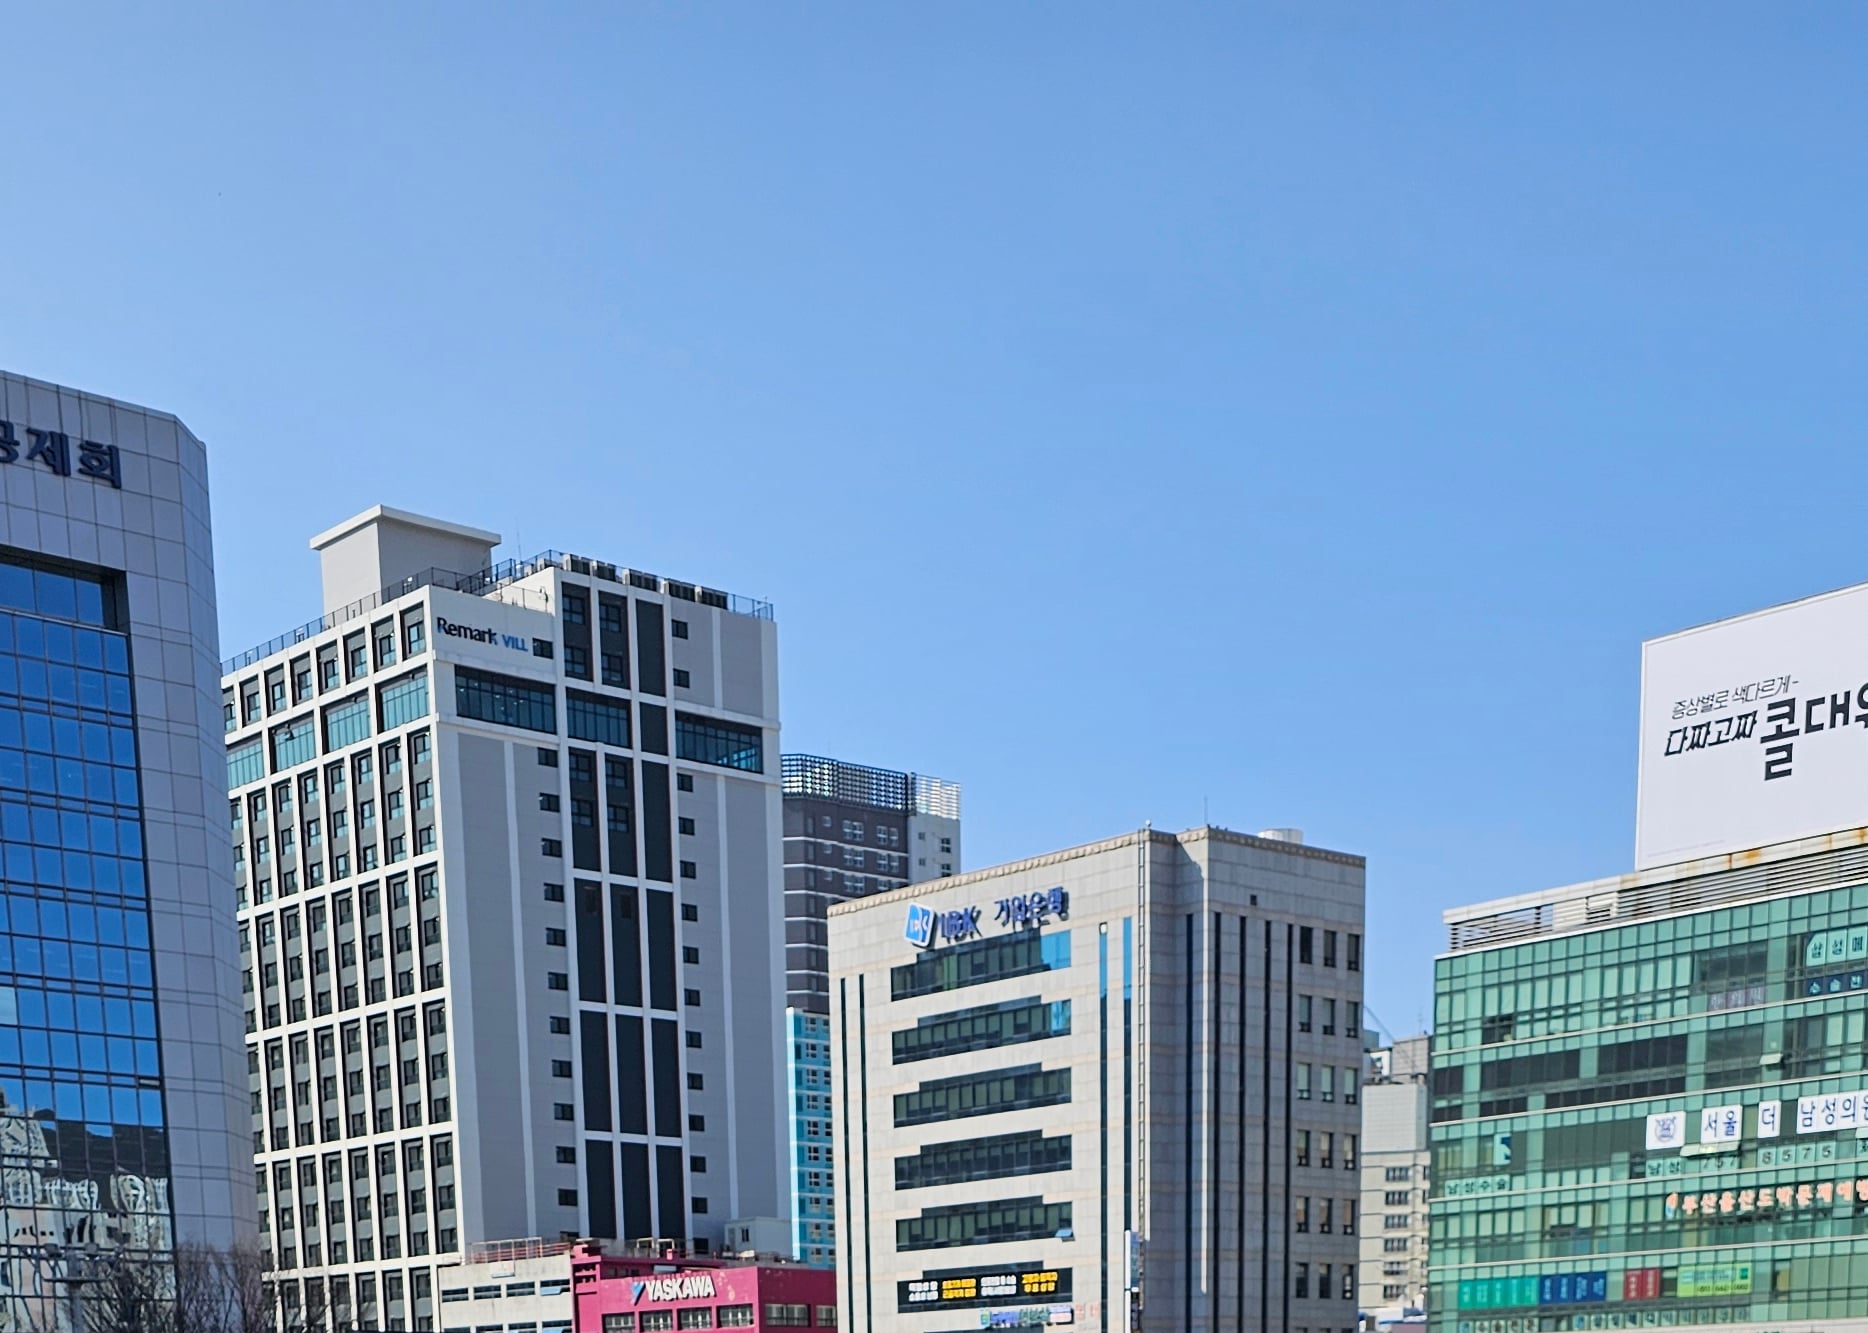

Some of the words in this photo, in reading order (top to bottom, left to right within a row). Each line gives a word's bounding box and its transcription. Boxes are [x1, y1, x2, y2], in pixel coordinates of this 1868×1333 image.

[437, 616, 498, 645] Remark
[502, 634, 528, 652] VILL
[1672, 690, 1729, 720] 증상별로
[1664, 710, 1758, 757] 다짜고짜
[1760, 682, 1868, 781] 콜대
[940, 905, 979, 938] IBK
[994, 886, 1064, 926] 기업은행
[1705, 1110, 1737, 1138] 서울
[1761, 1105, 1775, 1132] 더
[645, 1275, 716, 1302] YASKAWA
